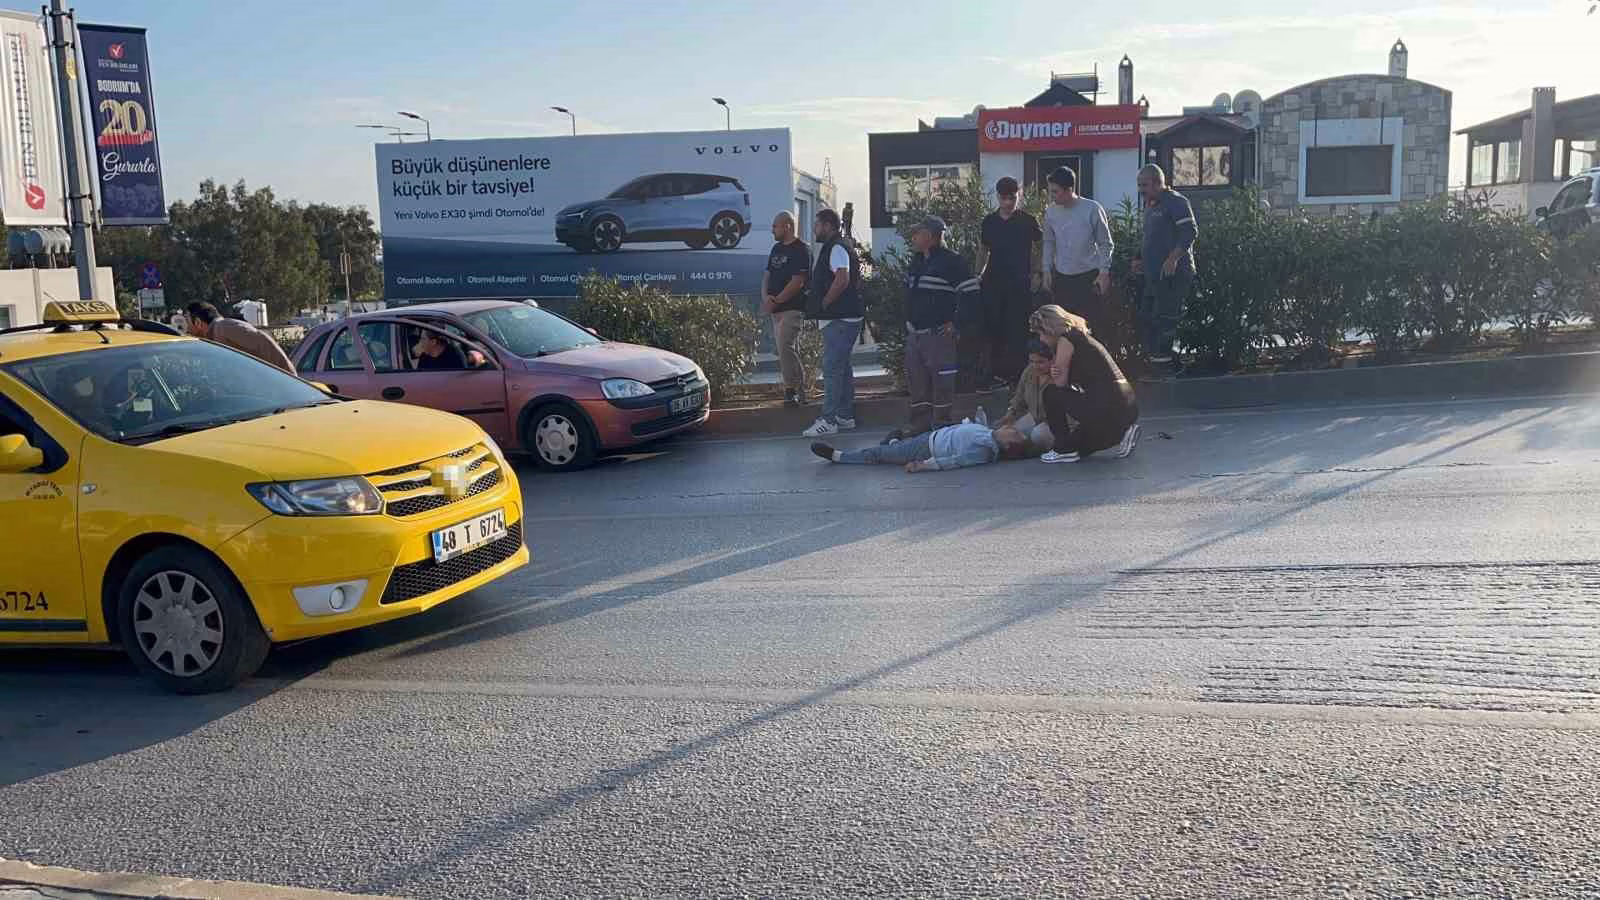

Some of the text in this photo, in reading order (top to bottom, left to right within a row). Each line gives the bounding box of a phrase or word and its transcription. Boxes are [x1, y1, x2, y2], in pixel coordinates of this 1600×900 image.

[97, 79, 141, 94] BODRUM'DA
[99, 99, 146, 136] 20
[997, 120, 1072, 140] Duymer
[695, 144, 779, 155] VOLVO
[101, 151, 157, 181] Gururla
[391, 155, 551, 177] Büyük düşünenlere
[393, 177, 535, 200] küçük bir tavsiye!
[394, 206, 545, 220] Yeni Volvo EX30 şimdi Otomol'de!
[396, 275, 455, 285] Otomol Bodrum
[467, 275, 495, 284] Otomol
[540, 273, 569, 283] Otomol
[690, 271, 706, 281] 444
[717, 271, 733, 281] 976
[442, 512, 503, 552] 48 T 6724
